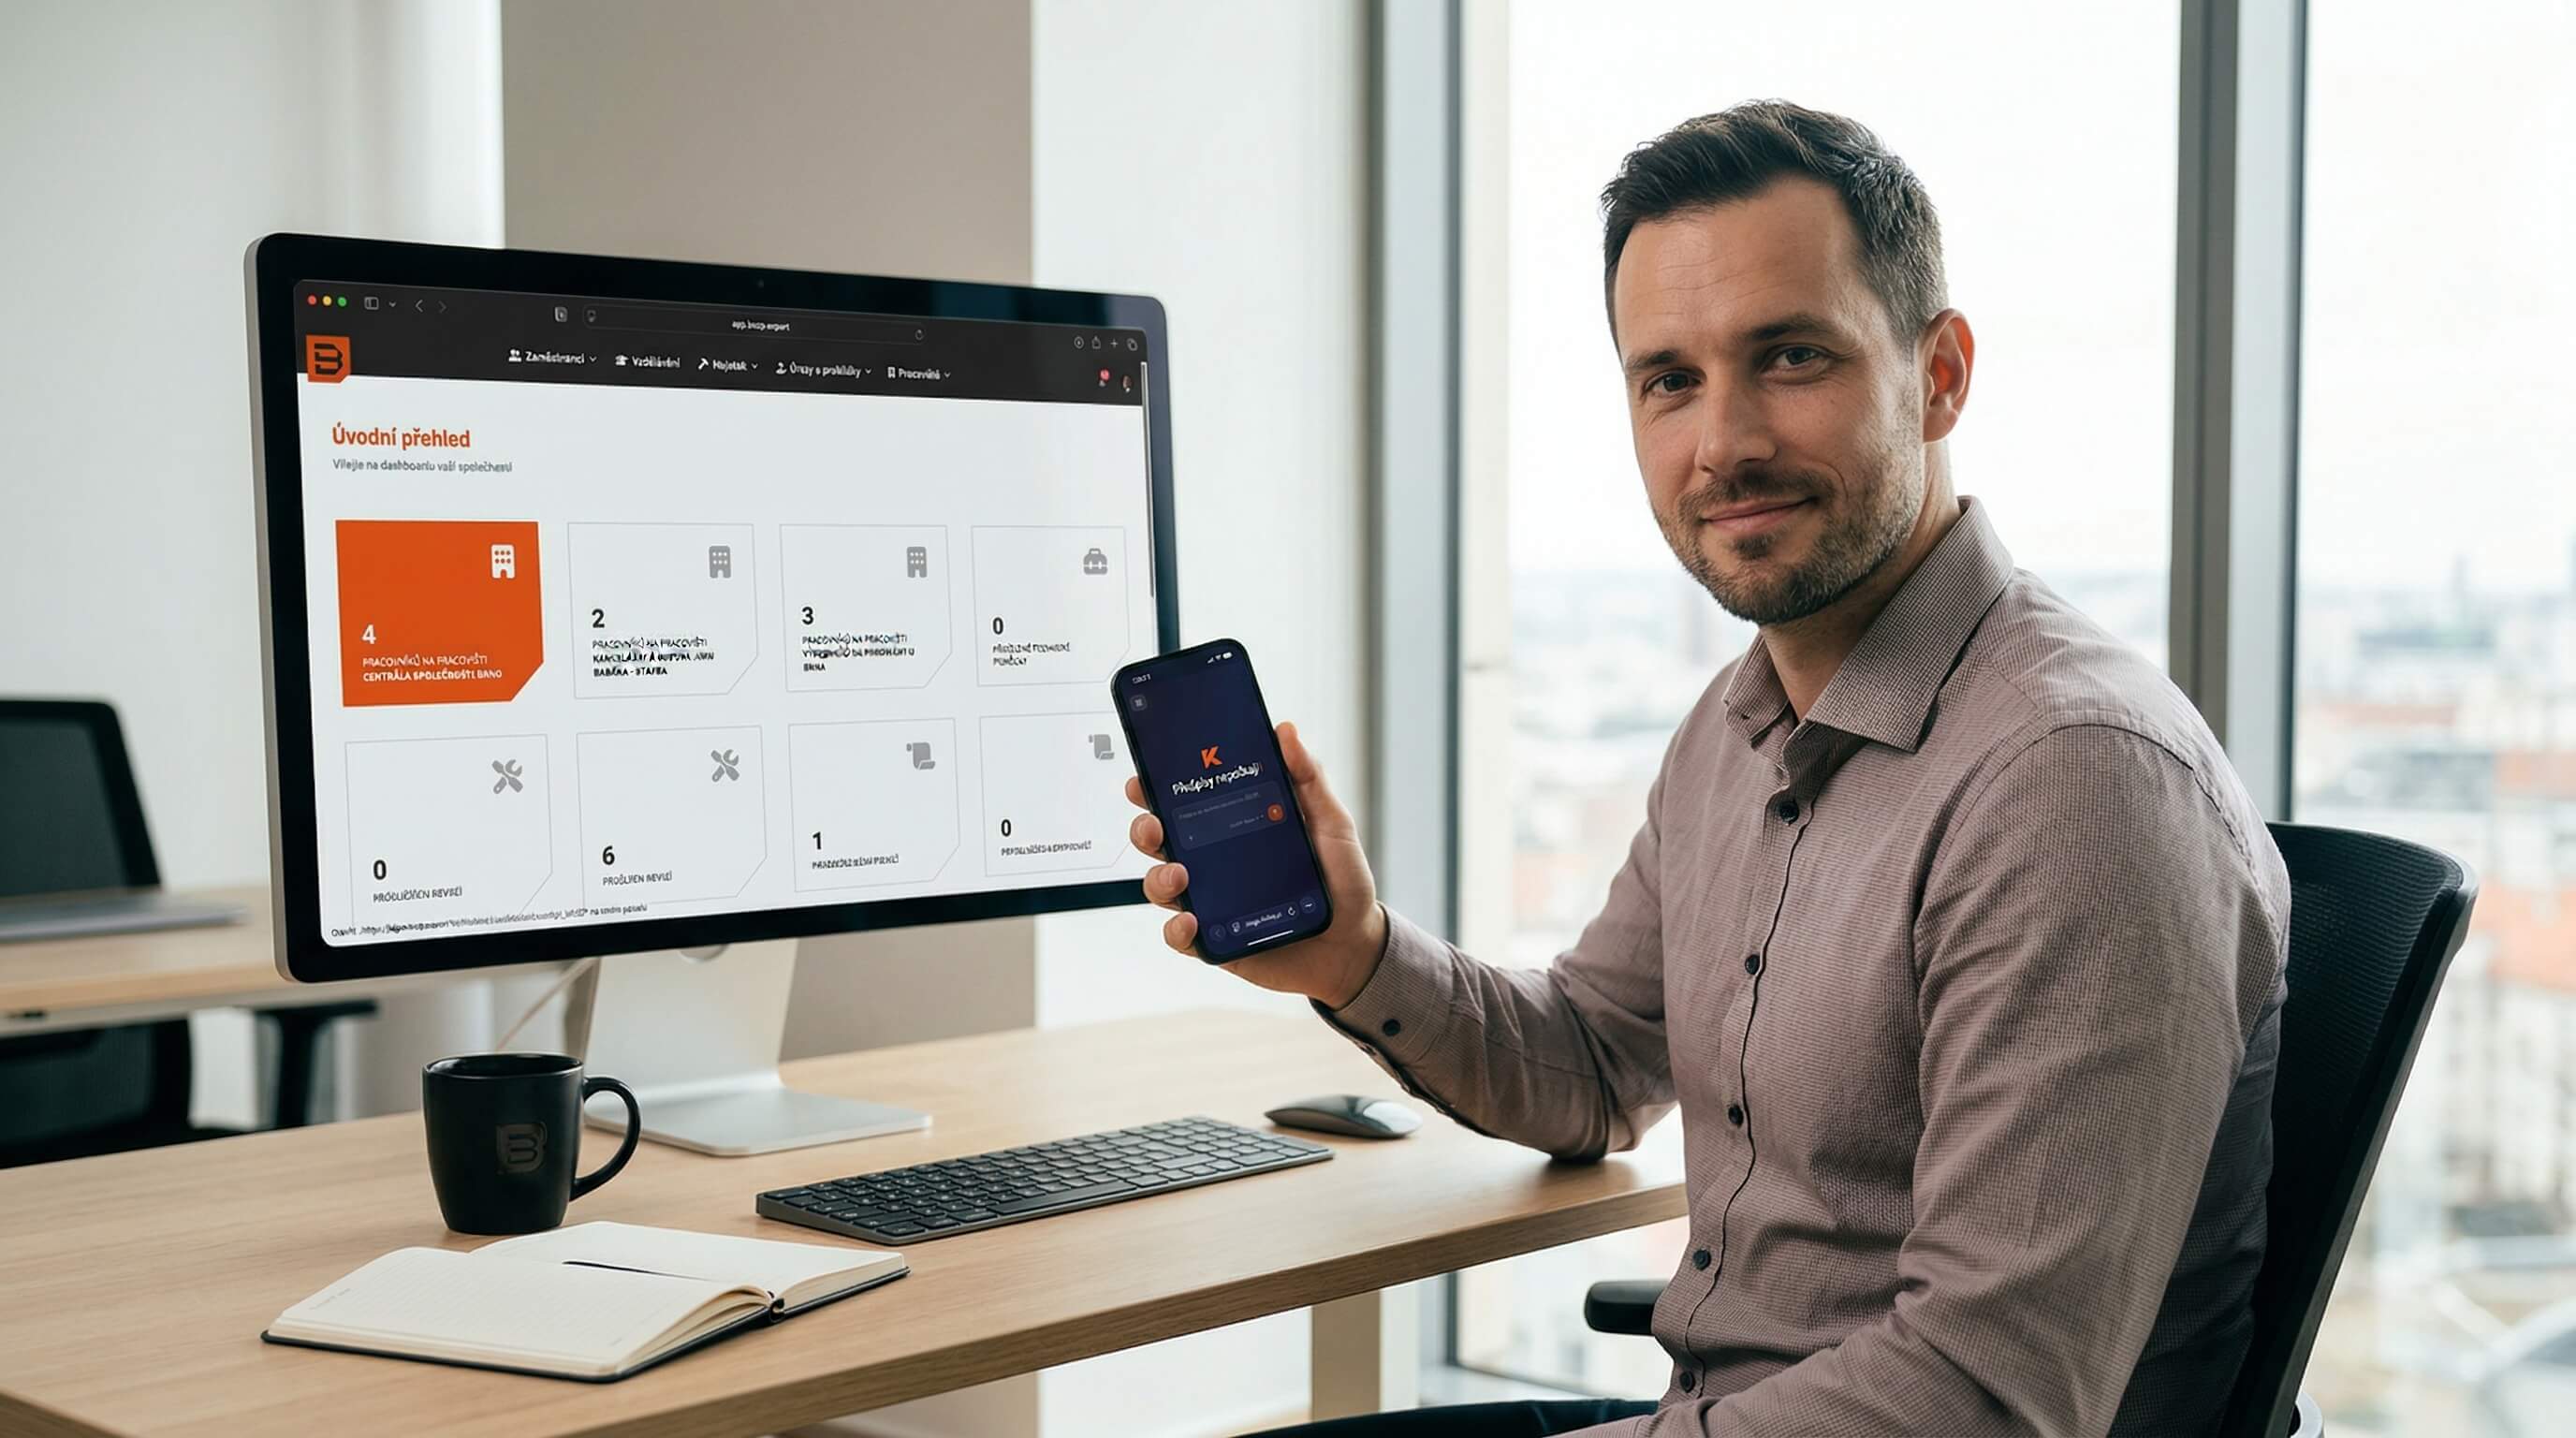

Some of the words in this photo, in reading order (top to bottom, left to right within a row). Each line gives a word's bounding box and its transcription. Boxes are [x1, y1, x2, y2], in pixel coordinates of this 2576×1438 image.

[332, 421, 397, 446] Úvodní
[402, 427, 471, 450] přehled
[366, 461, 378, 471] na
[592, 609, 606, 628] 2
[801, 607, 814, 625] 3
[992, 616, 1004, 635] 0
[361, 624, 377, 645] 4
[422, 655, 435, 666] NA
[1201, 745, 1223, 770] K
[1001, 818, 1012, 838] 0
[812, 831, 822, 850] 1
[602, 844, 616, 866] 6
[373, 858, 388, 881] 0
